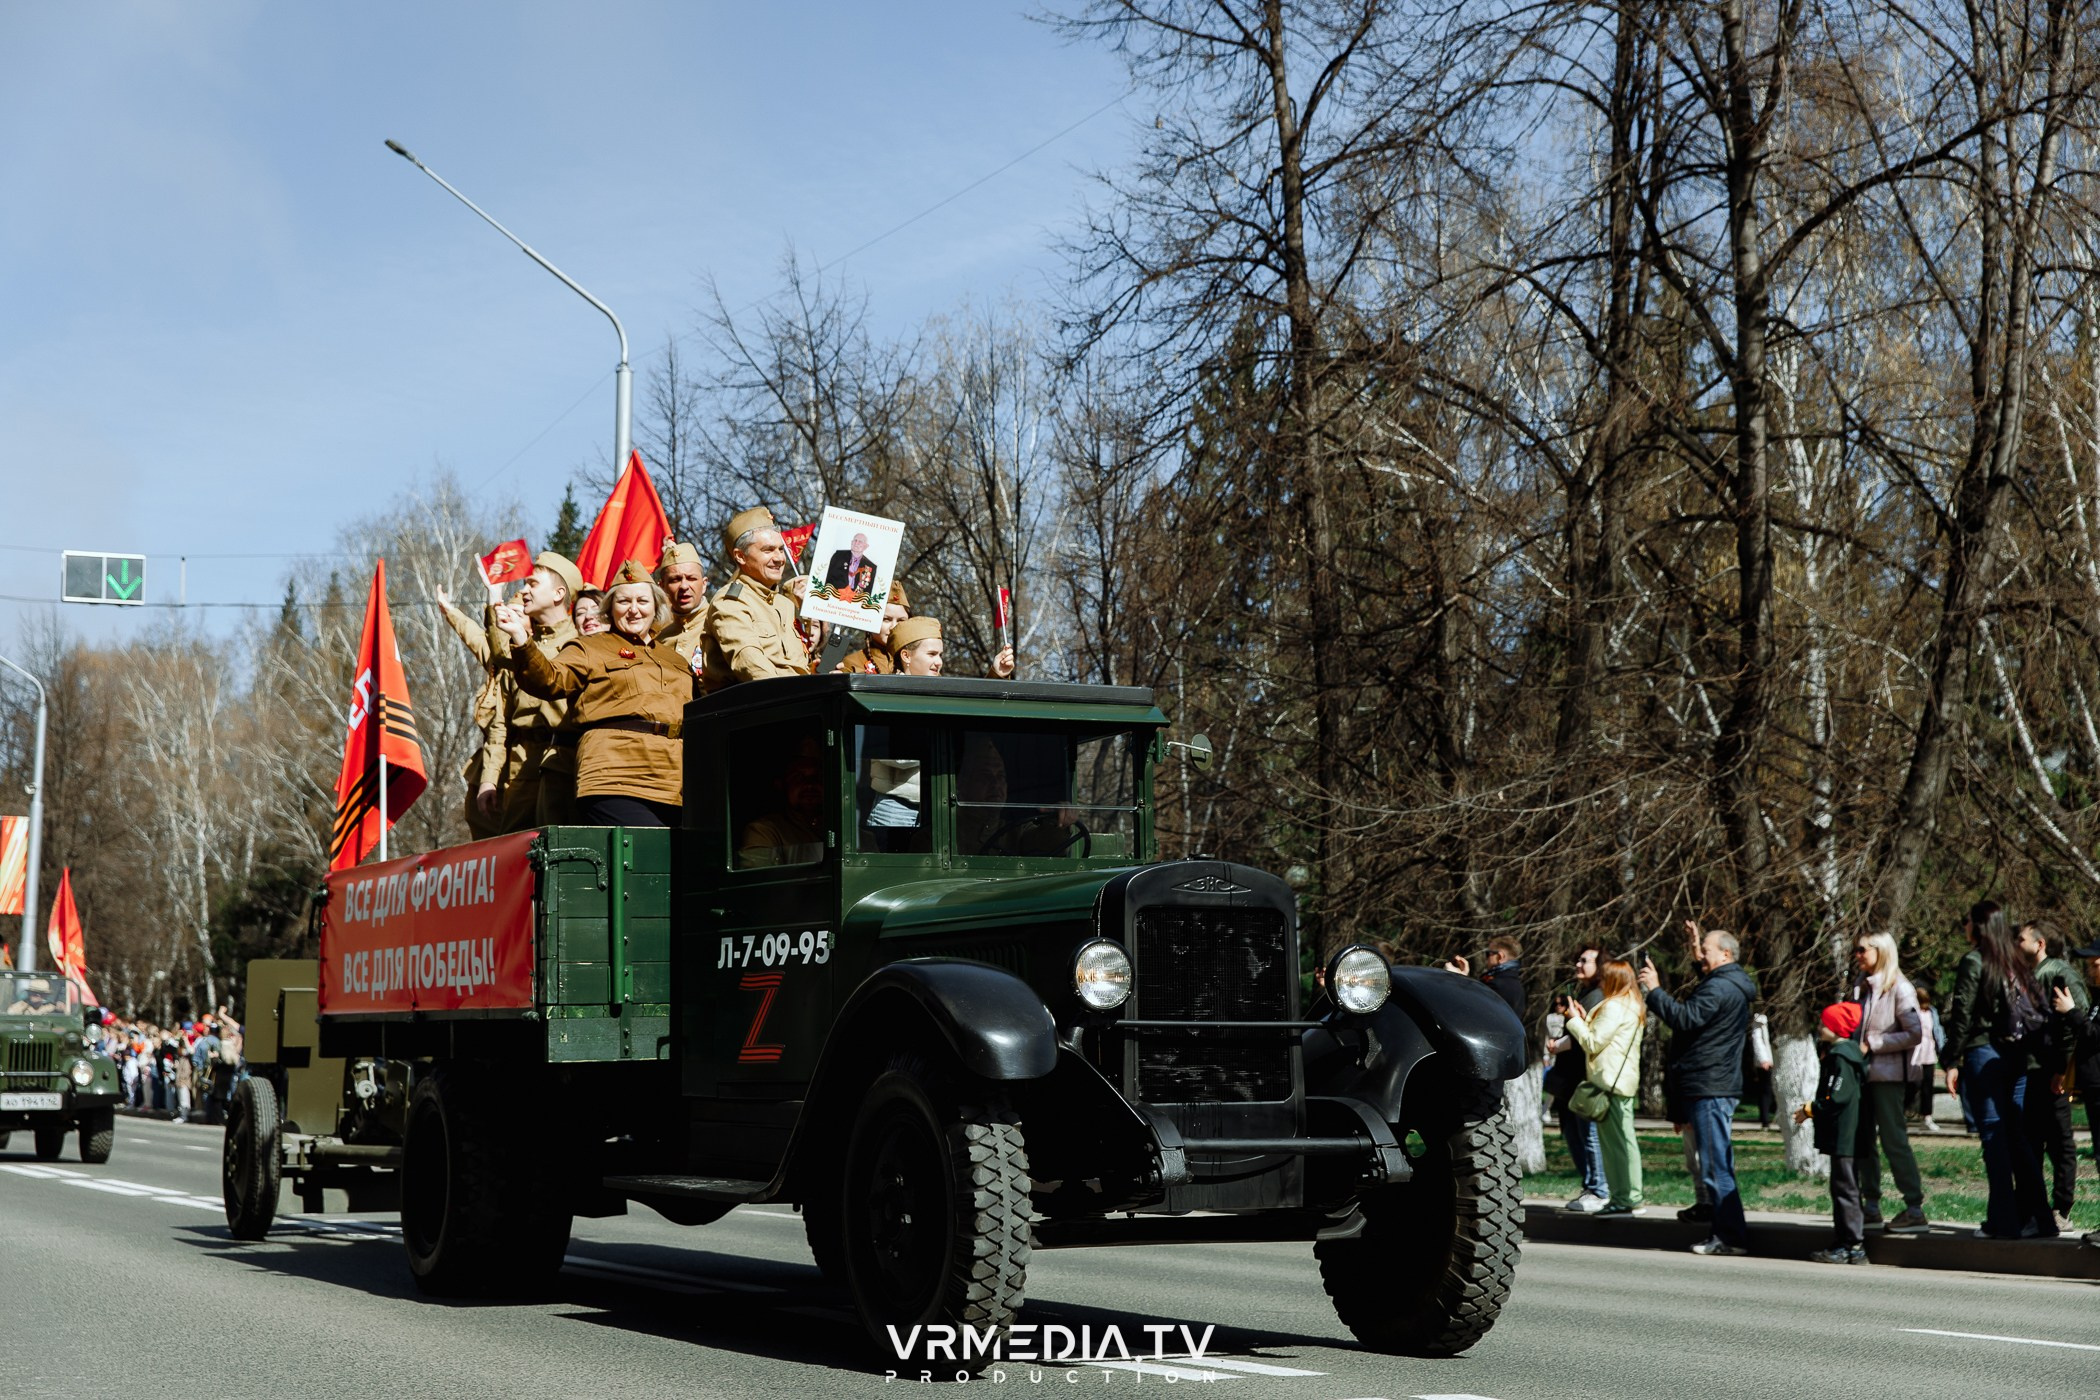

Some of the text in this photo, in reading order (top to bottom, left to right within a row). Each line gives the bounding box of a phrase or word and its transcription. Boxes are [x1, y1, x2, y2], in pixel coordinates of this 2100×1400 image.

[879, 523, 899, 533] ПОЛК
[344, 856, 496, 928] ВСЕ ДЛЯ ФРОНТА!
[344, 938, 496, 1000] ВСЕ ДЛЯ ПОБЕДЫ!
[717, 930, 830, 969] Л-7-09-95
[738, 971, 785, 1063] Z
